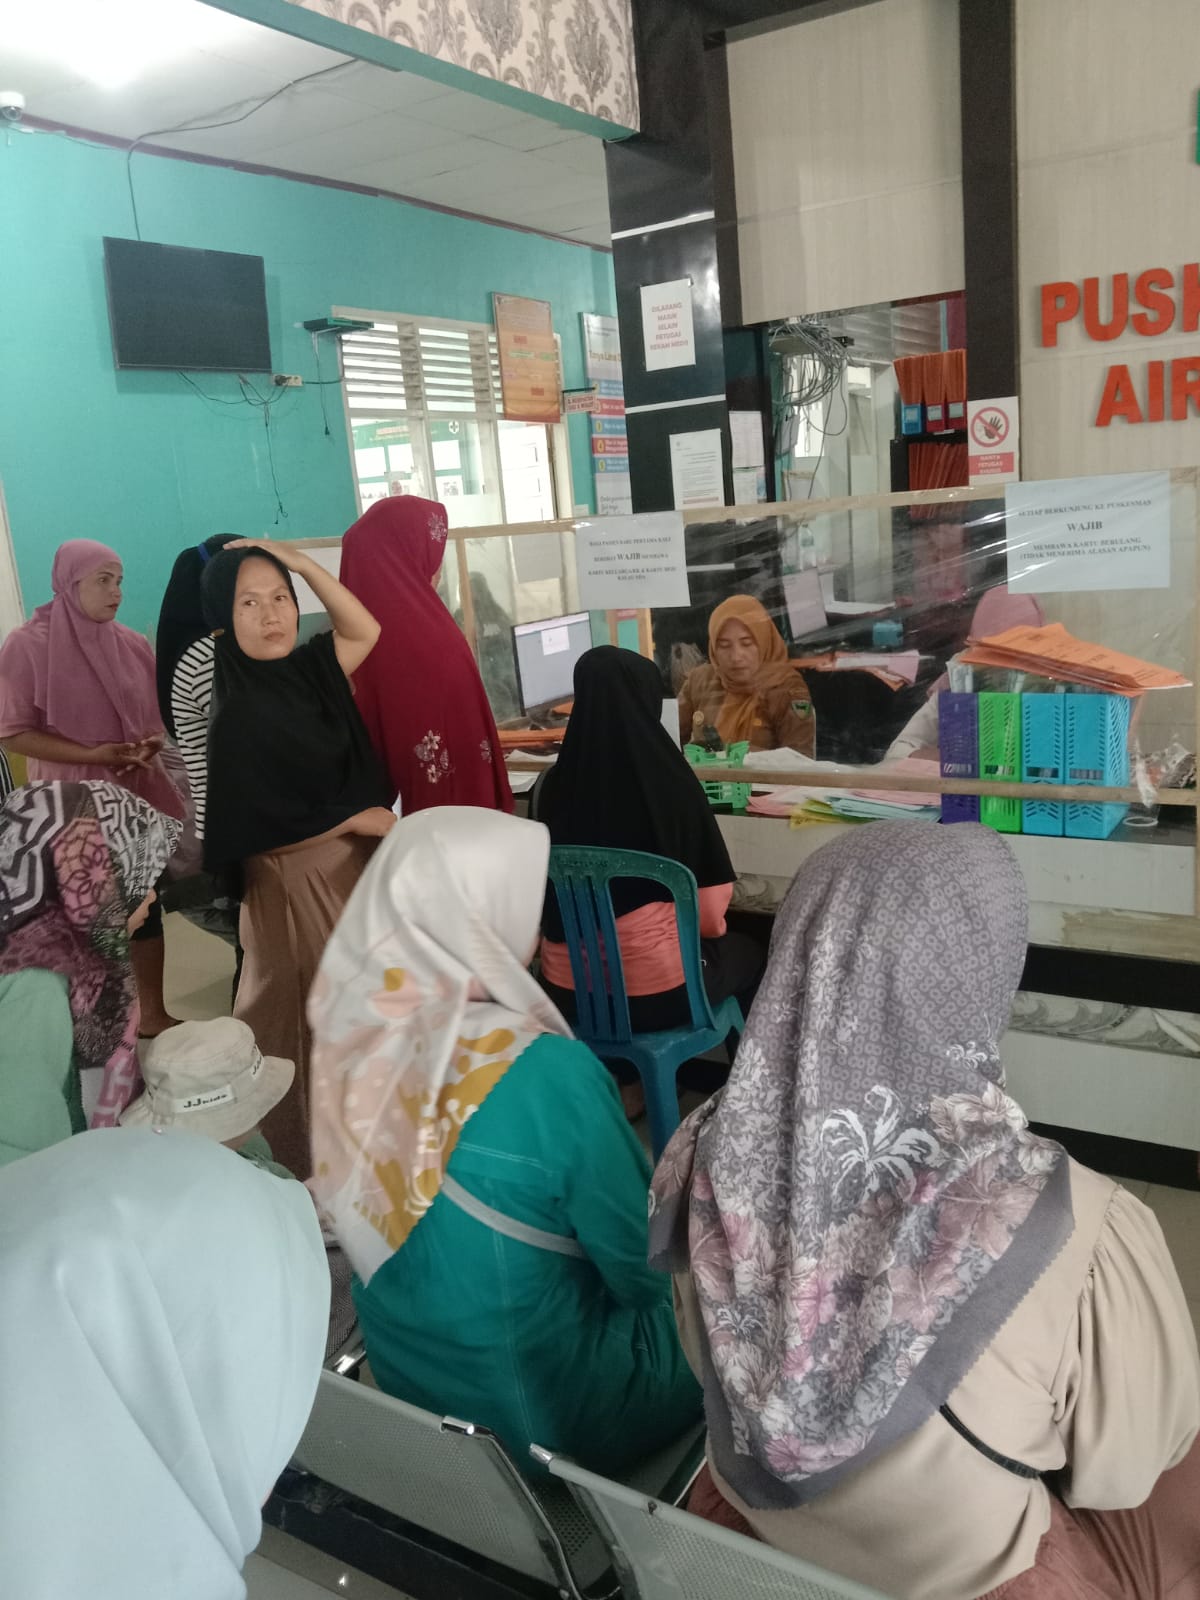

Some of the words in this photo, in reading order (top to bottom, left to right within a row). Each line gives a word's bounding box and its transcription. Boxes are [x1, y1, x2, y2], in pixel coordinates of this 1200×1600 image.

[1094, 356, 1200, 429] AIR
[1018, 509, 1043, 517] SETIAP
[1044, 505, 1093, 515] BERKUNJUNG
[1067, 521, 1103, 532] WAJIB
[1033, 542, 1072, 551] MEMBAWA
[1073, 540, 1098, 549] KARTU
[1100, 537, 1142, 547] BERULANG
[616, 553, 641, 561] WAJIB
